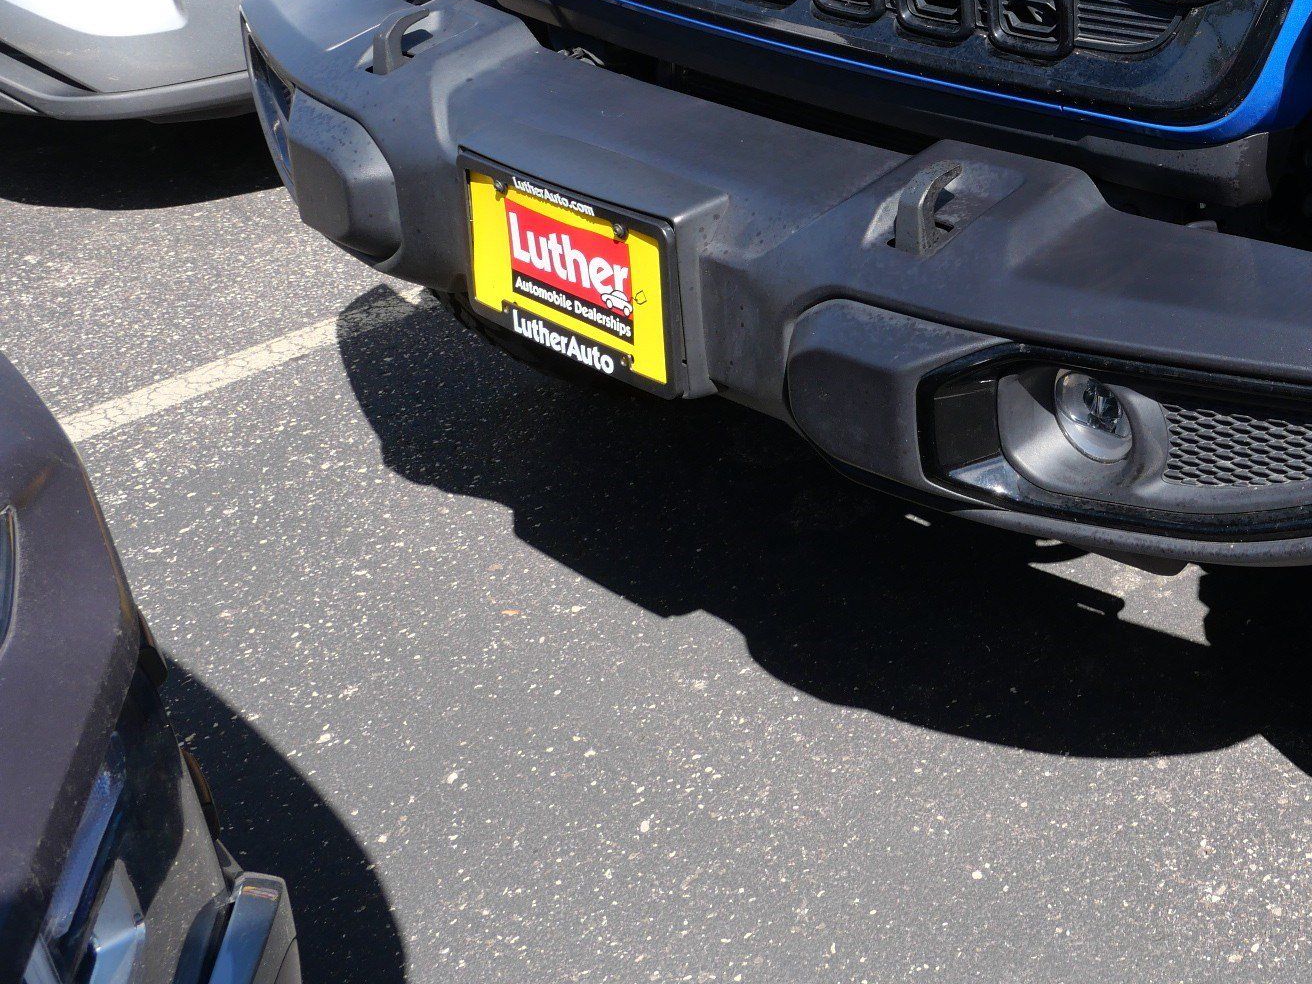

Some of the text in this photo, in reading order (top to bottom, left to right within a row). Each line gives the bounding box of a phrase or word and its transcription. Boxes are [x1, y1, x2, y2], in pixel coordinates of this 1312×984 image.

[512, 176, 595, 217] LutherAuto.com
[508, 211, 629, 294] Luther
[514, 276, 632, 337] Automobile Dealerships
[512, 309, 614, 374] LutherAuto
